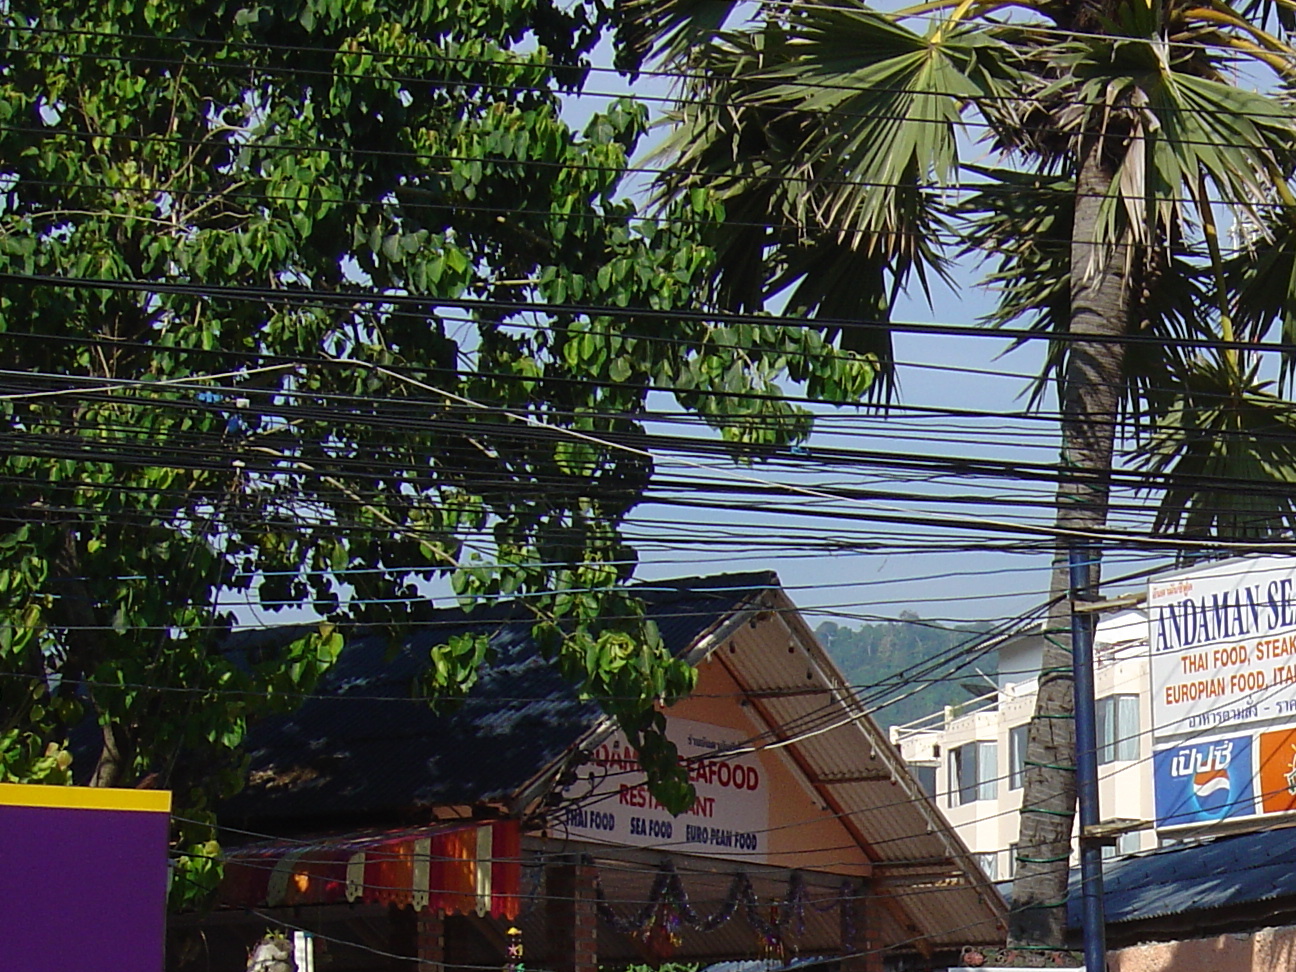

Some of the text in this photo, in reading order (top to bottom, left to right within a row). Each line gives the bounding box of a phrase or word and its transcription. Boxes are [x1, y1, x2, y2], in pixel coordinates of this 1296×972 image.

[1156, 584, 1260, 652] ANDAMAN
[1181, 653, 1209, 674] THAI
[1213, 645, 1251, 671] FOOD,
[1165, 679, 1225, 705] EUROPIAN
[1230, 672, 1268, 696] FOOD,
[589, 810, 615, 831] FOOD
[630, 816, 647, 836] SEA
[648, 819, 673, 839] FOOD
[685, 824, 709, 844] EURO
[734, 832, 758, 851] FOOD
